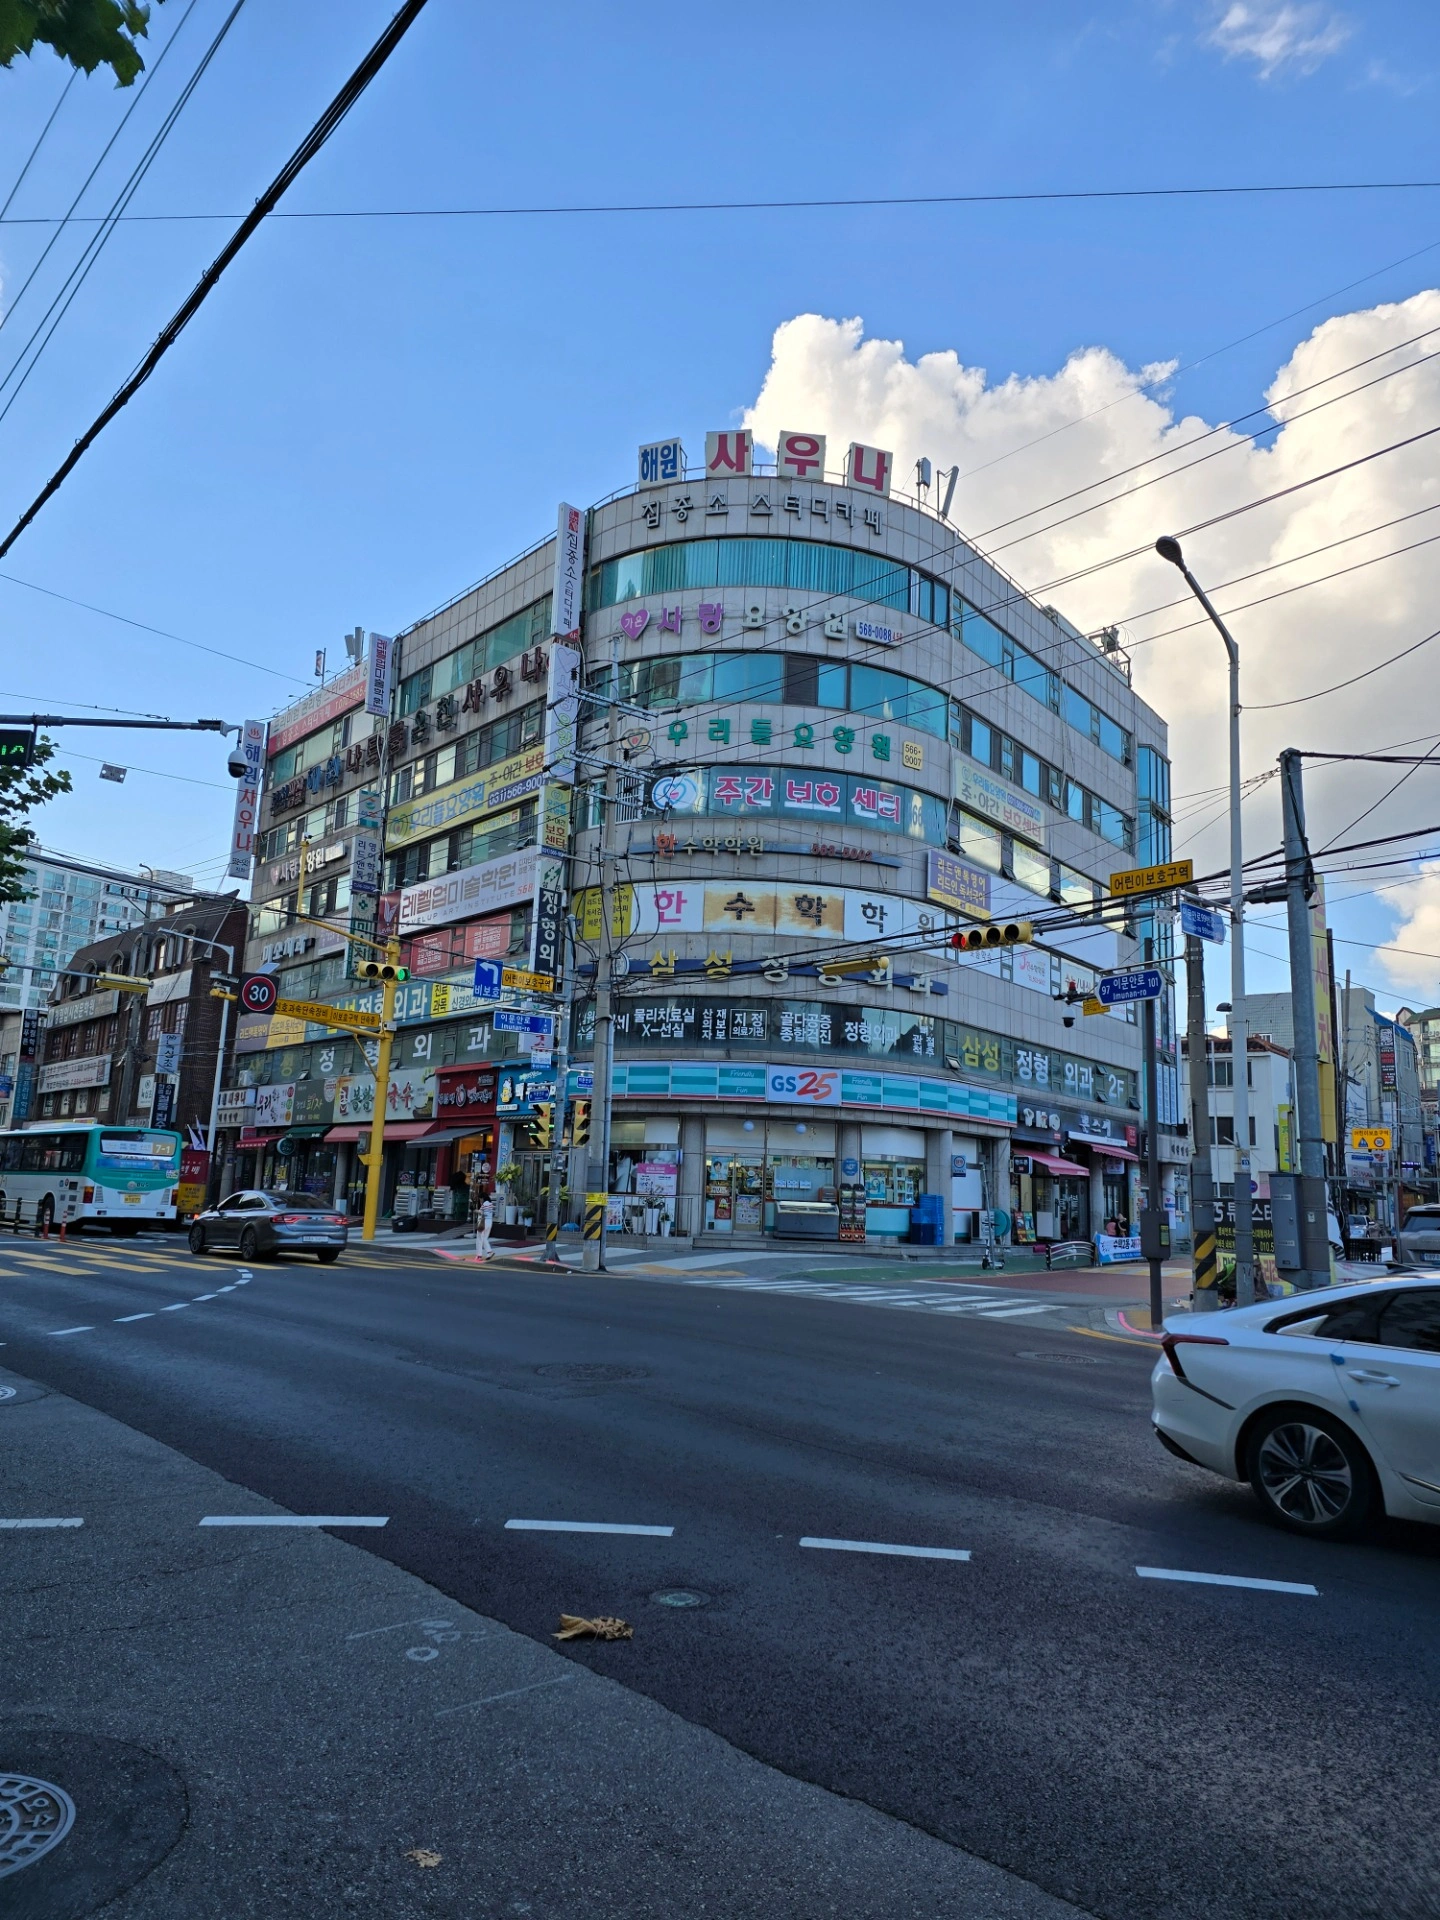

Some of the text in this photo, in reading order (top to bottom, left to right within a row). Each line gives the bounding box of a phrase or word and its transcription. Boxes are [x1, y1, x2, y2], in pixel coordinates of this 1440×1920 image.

[641, 433, 888, 491] 해원 사우나
[641, 493, 883, 535] 집중소 스터디카페
[564, 532, 579, 629] 집중소스터디카페
[462, 646, 546, 713] 사우나
[668, 719, 890, 761] 우리들요양원
[245, 743, 261, 785] 해원
[904, 754, 922, 768] 9007
[714, 775, 774, 805] 주간
[785, 779, 840, 807] 보호
[851, 787, 901, 823] 센터
[236, 788, 256, 851] 사우나
[545, 824, 566, 837] 보호
[545, 836, 565, 849] 센터
[1114, 864, 1190, 891] 어린이보호구역
[474, 983, 500, 998] 비보호
[504, 974, 552, 990] 어린이보호구역
[1101, 974, 1159, 996] 97 이문안로 101
[249, 985, 269, 1003] 30
[1113, 989, 1147, 1001] Imunan-ro
[432, 999, 447, 1012] 과목
[500, 1014, 531, 1026] 이문안로
[634, 1007, 695, 1023] 물리치료실
[734, 1012, 763, 1027] 지정
[780, 1011, 832, 1030] 골다공증
[844, 1020, 897, 1046] 정형외과
[641, 1023, 685, 1038] X-선실
[732, 1026, 764, 1037] 의료기관
[779, 1027, 832, 1045] 종합검진
[961, 1036, 998, 1071] 삼성
[1108, 1074, 1125, 1098] 2F
[735, 1086, 748, 1094] Fun
[771, 1071, 838, 1100] GS25
[156, 1144, 171, 1155] 7-1
